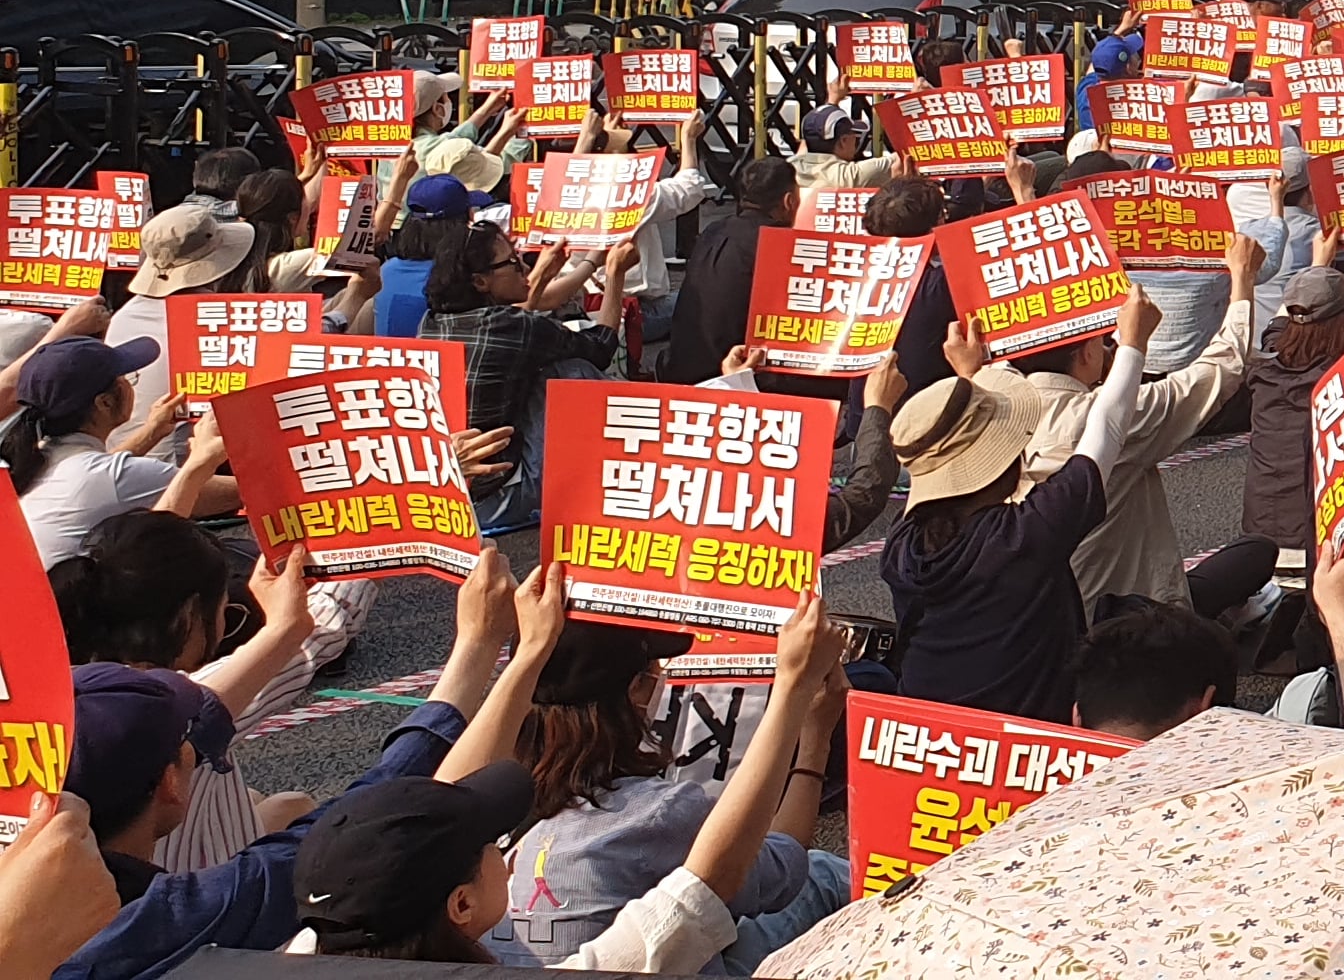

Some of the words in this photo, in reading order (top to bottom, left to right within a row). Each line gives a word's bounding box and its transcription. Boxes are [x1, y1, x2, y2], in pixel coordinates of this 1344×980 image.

[1160, 18, 1229, 40] 투표항쟁
[620, 53, 691, 74] 투표항쟁
[1159, 39, 1226, 59] 떨쳐나서
[313, 75, 404, 103] 투표항쟁
[622, 73, 692, 94] 떨쳐나서
[320, 101, 405, 124] 떨쳐나서
[899, 92, 985, 120] 투표항쟁
[1184, 102, 1269, 126] 투표항쟁
[907, 114, 995, 142] 떨쳐나서
[1189, 124, 1272, 146] 떨쳐나서
[564, 154, 656, 182] 투표항쟁
[1155, 179, 1218, 201] 대선지휘
[7, 194, 114, 225] 투표항쟁
[1113, 199, 1197, 225] 윤석열을
[971, 198, 1094, 258] 투표항쟁
[790, 238, 924, 278] 투표항쟁
[982, 237, 1108, 299] 떨쳐나서
[787, 275, 907, 317] 떨쳐나서
[196, 300, 308, 334] 투표항쟁
[754, 315, 843, 346] 내란세력
[272, 373, 449, 436] 투표항쟁
[603, 395, 803, 471] 투표항쟁
[288, 433, 467, 494] 떨쳐나서
[601, 459, 796, 538] 떨쳐나서
[262, 492, 401, 547] 내란세력
[553, 524, 684, 578] 내란세력
[687, 535, 814, 595] 응징하자!
[750, 607, 776, 619] 모이자!
[858, 716, 999, 788] 내란수괴
